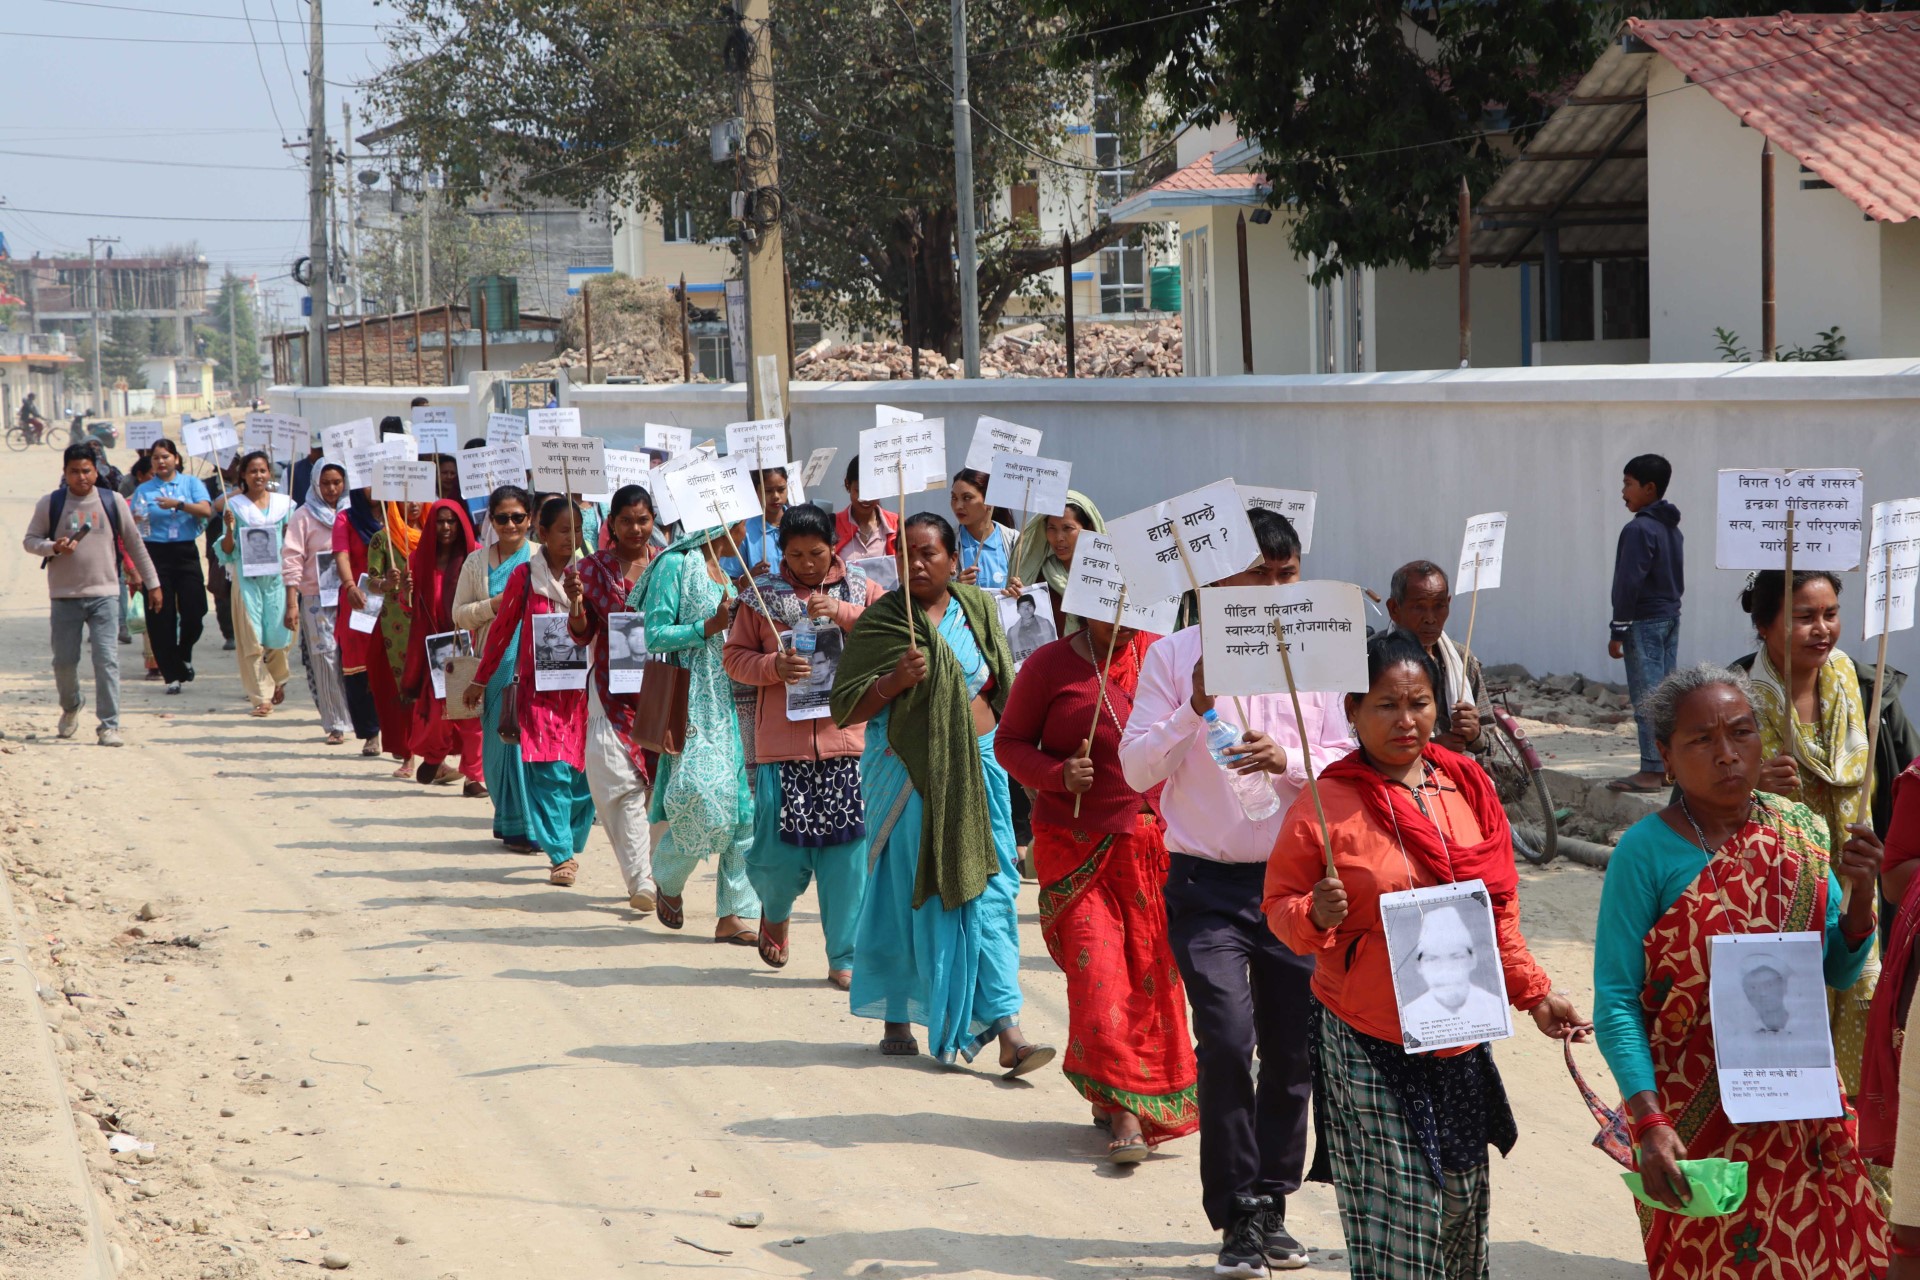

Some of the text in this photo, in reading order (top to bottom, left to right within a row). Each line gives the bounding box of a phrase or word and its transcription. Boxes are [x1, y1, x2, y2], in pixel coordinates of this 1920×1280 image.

[720, 467, 738, 479] आम
[1739, 475, 1856, 489] विगत १० वर्षे शसस्त्र
[1288, 501, 1306, 511] आम
[1744, 496, 1849, 510] द्वन्द्वका पीडितहरुको
[1146, 503, 1215, 541] हाम्रो मान्छे
[1729, 519, 1756, 532] सत्य,
[1807, 517, 1862, 535] परिपुरणको
[1189, 534, 1217, 552] छन्
[1806, 541, 1822, 552] गर
[1224, 599, 1313, 618] पीडित परिवारको
[1226, 641, 1269, 656] ग्यारेन्टी
[1743, 1069, 1754, 1077] मेरो
[1756, 1069, 1767, 1077] मेरो
